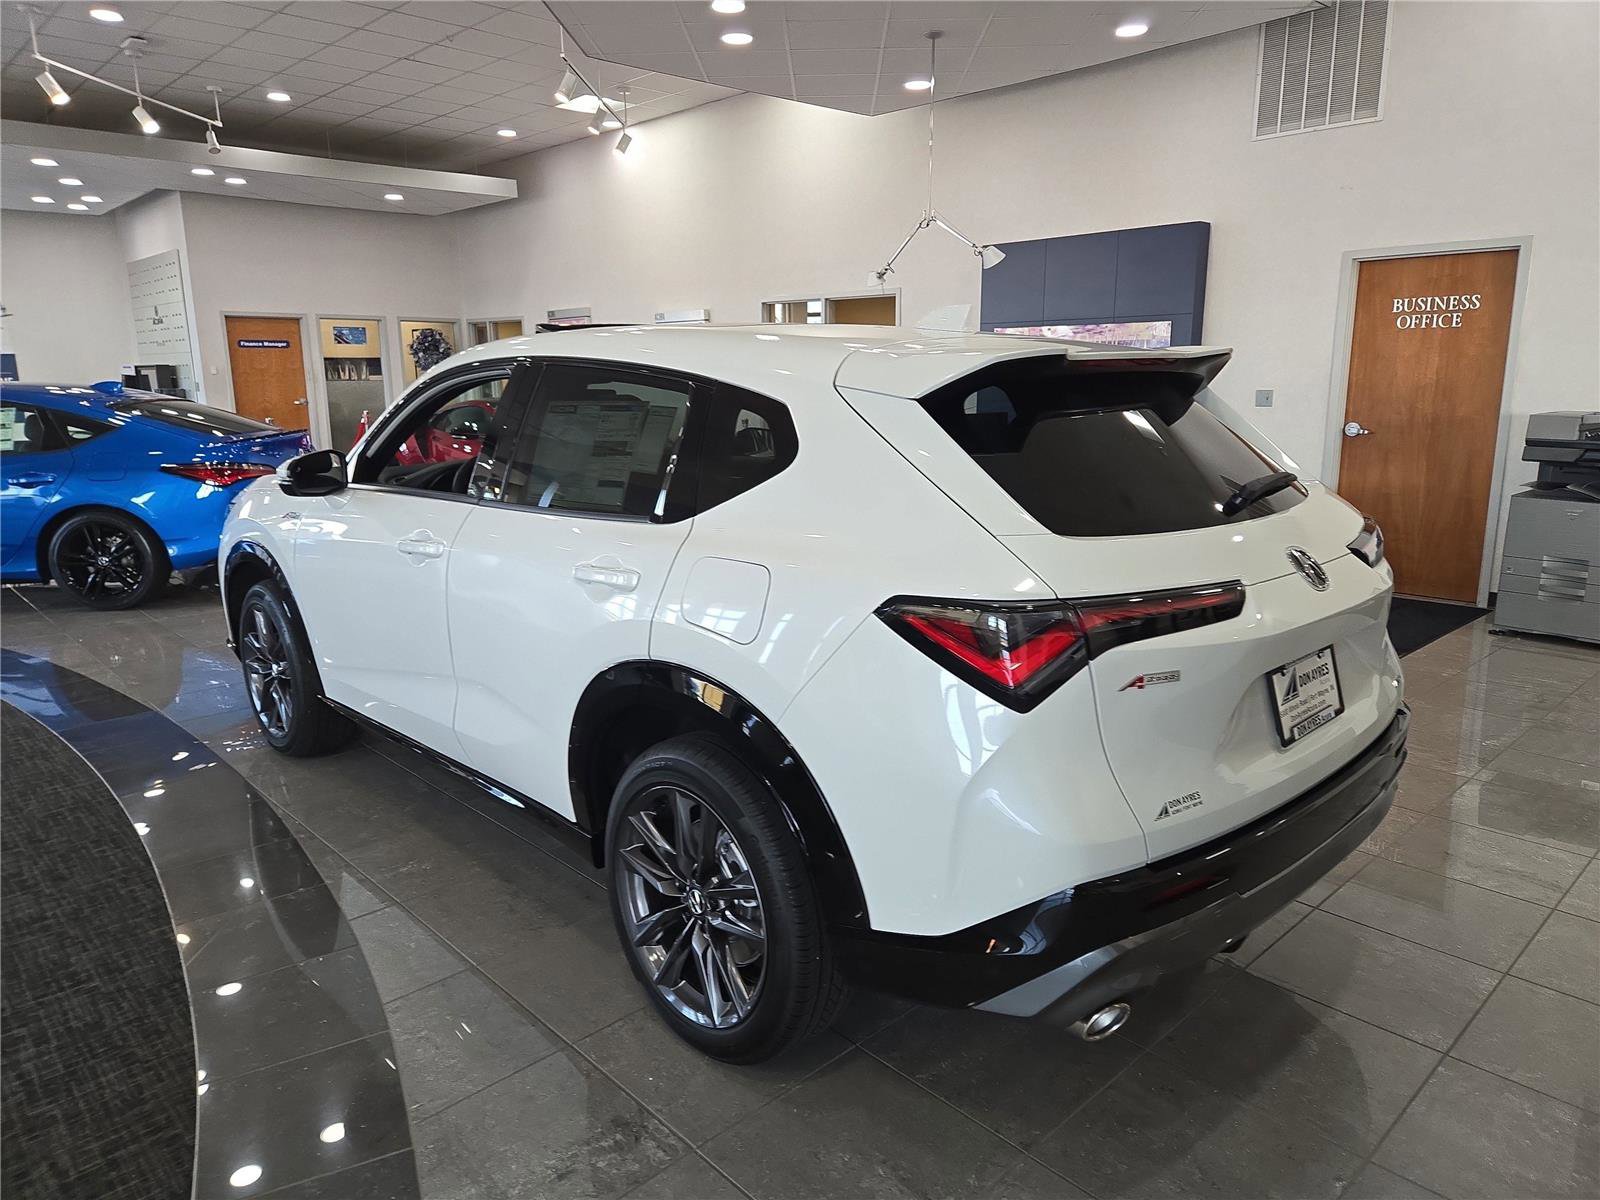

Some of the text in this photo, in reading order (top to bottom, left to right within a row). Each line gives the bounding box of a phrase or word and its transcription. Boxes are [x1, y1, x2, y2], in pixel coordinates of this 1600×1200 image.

[1392, 294, 1481, 313] BUSINESS
[1396, 312, 1463, 330] OFFICE
[1298, 662, 1330, 688] DON AYRES
[1296, 722, 1309, 737] DON
[1307, 714, 1322, 731] AYRES
[1167, 790, 1201, 809] DON AYRES
